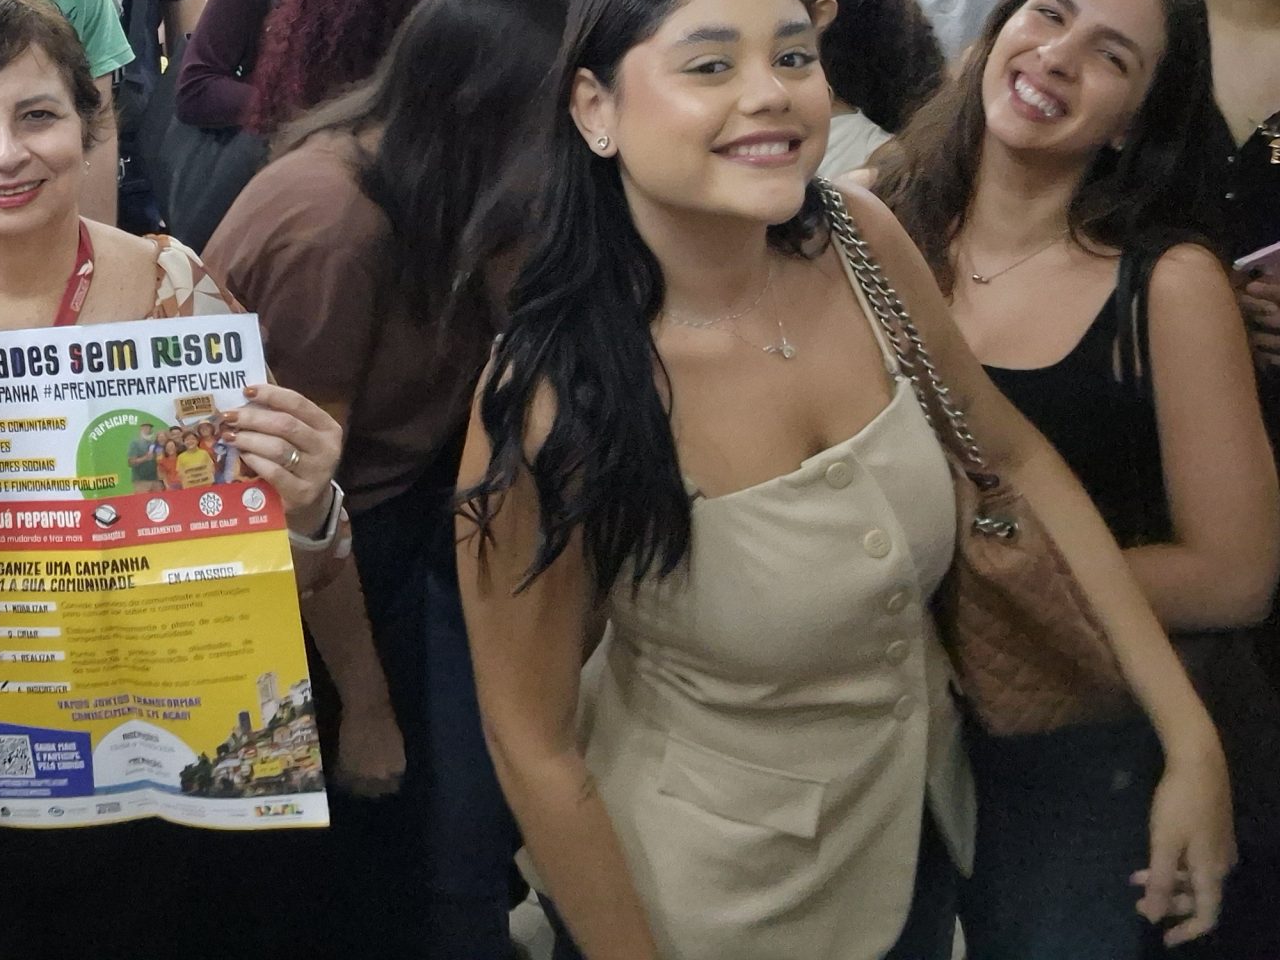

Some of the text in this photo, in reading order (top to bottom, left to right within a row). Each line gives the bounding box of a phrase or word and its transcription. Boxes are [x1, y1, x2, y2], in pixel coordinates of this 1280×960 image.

[44, 370, 248, 401] #APRENDERPARAPREVENIR
[22, 459, 55, 472] SOCIAIS
[4, 481, 10, 492] E
[7, 534, 41, 542] mudando
[49, 534, 63, 542] traz
[65, 534, 83, 542] mais
[46, 561, 71, 576] UMA
[76, 556, 150, 576] CAMPANHA
[9, 578, 17, 592] A
[22, 578, 46, 592] SUA
[51, 575, 135, 593] COMUNIDADE
[20, 654, 56, 663] REALIZAR
